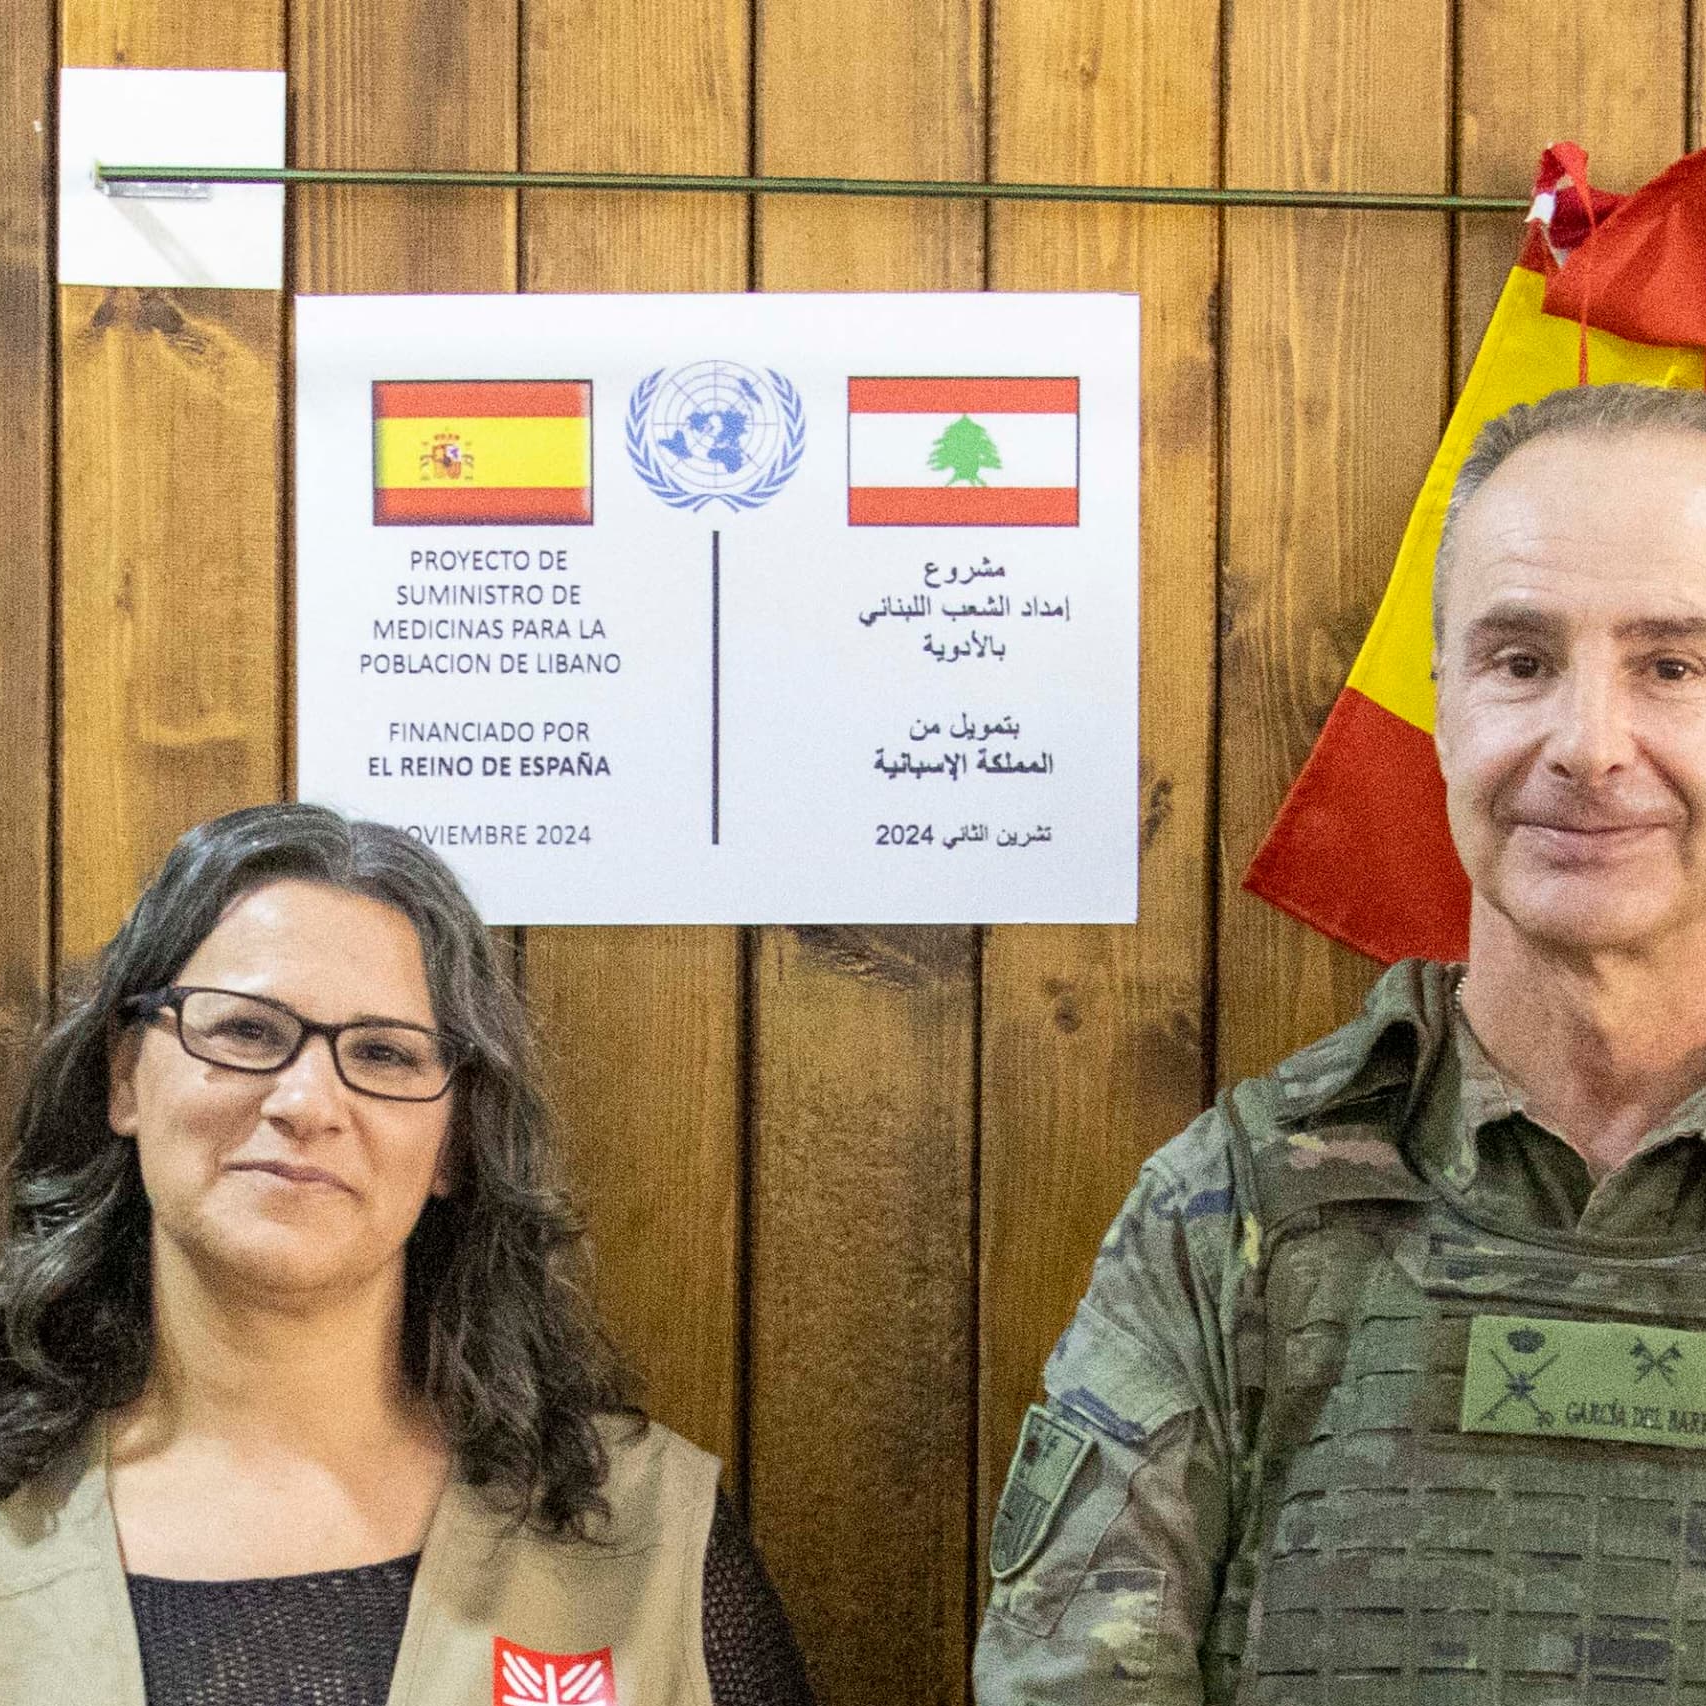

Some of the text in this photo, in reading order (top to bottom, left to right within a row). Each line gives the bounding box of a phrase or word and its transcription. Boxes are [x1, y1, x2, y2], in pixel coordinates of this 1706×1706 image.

[410, 550, 569, 571] PROYECTO DE
[924, 557, 1006, 588] مشروع
[396, 584, 582, 605] SUMINISTRO DE
[859, 595, 1070, 626] إمداد الشعب اللبناني
[373, 619, 606, 640] MEDICINAS PARA LA
[923, 630, 1006, 662] بالأدوية
[360, 653, 622, 674] POBLACION DE LIBANO
[389, 721, 590, 742] FINANCIADO POR
[909, 712, 1020, 741] بتمويل من
[368, 752, 611, 776] EL REINO DE ESPAÑA
[874, 748, 1053, 781] المملكة الإسبانية
[400, 825, 591, 845] OVIEMBRE 2024
[875, 824, 1052, 849] تشرين الثاني 2024
